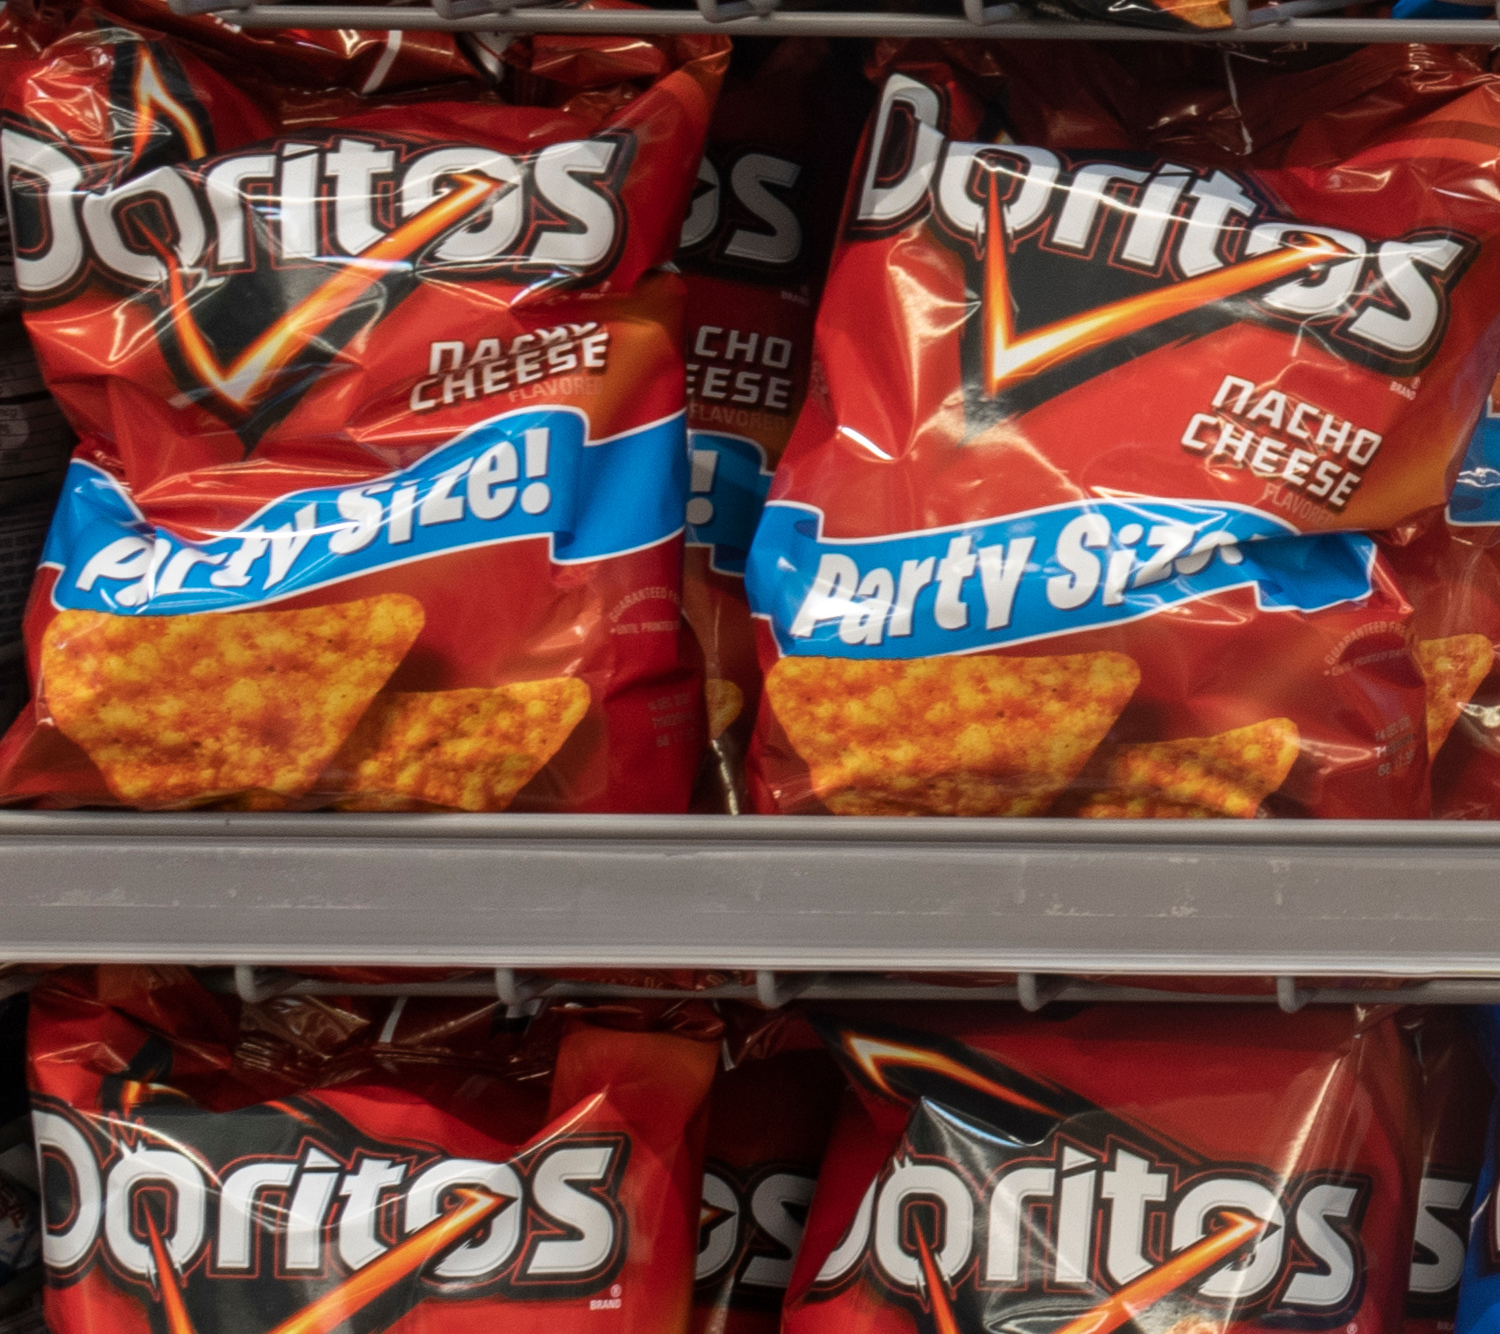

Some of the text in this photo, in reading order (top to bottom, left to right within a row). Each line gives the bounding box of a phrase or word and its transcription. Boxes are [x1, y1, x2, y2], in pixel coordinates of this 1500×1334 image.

[3, 130, 618, 291] Doritos
[858, 72, 1465, 353] Doritos
[410, 339, 610, 414] CHEESE
[1212, 375, 1382, 463] NACHO
[1181, 412, 1361, 508] CHEESE
[791, 533, 1033, 646] Party
[32, 1109, 616, 1279] Doritos
